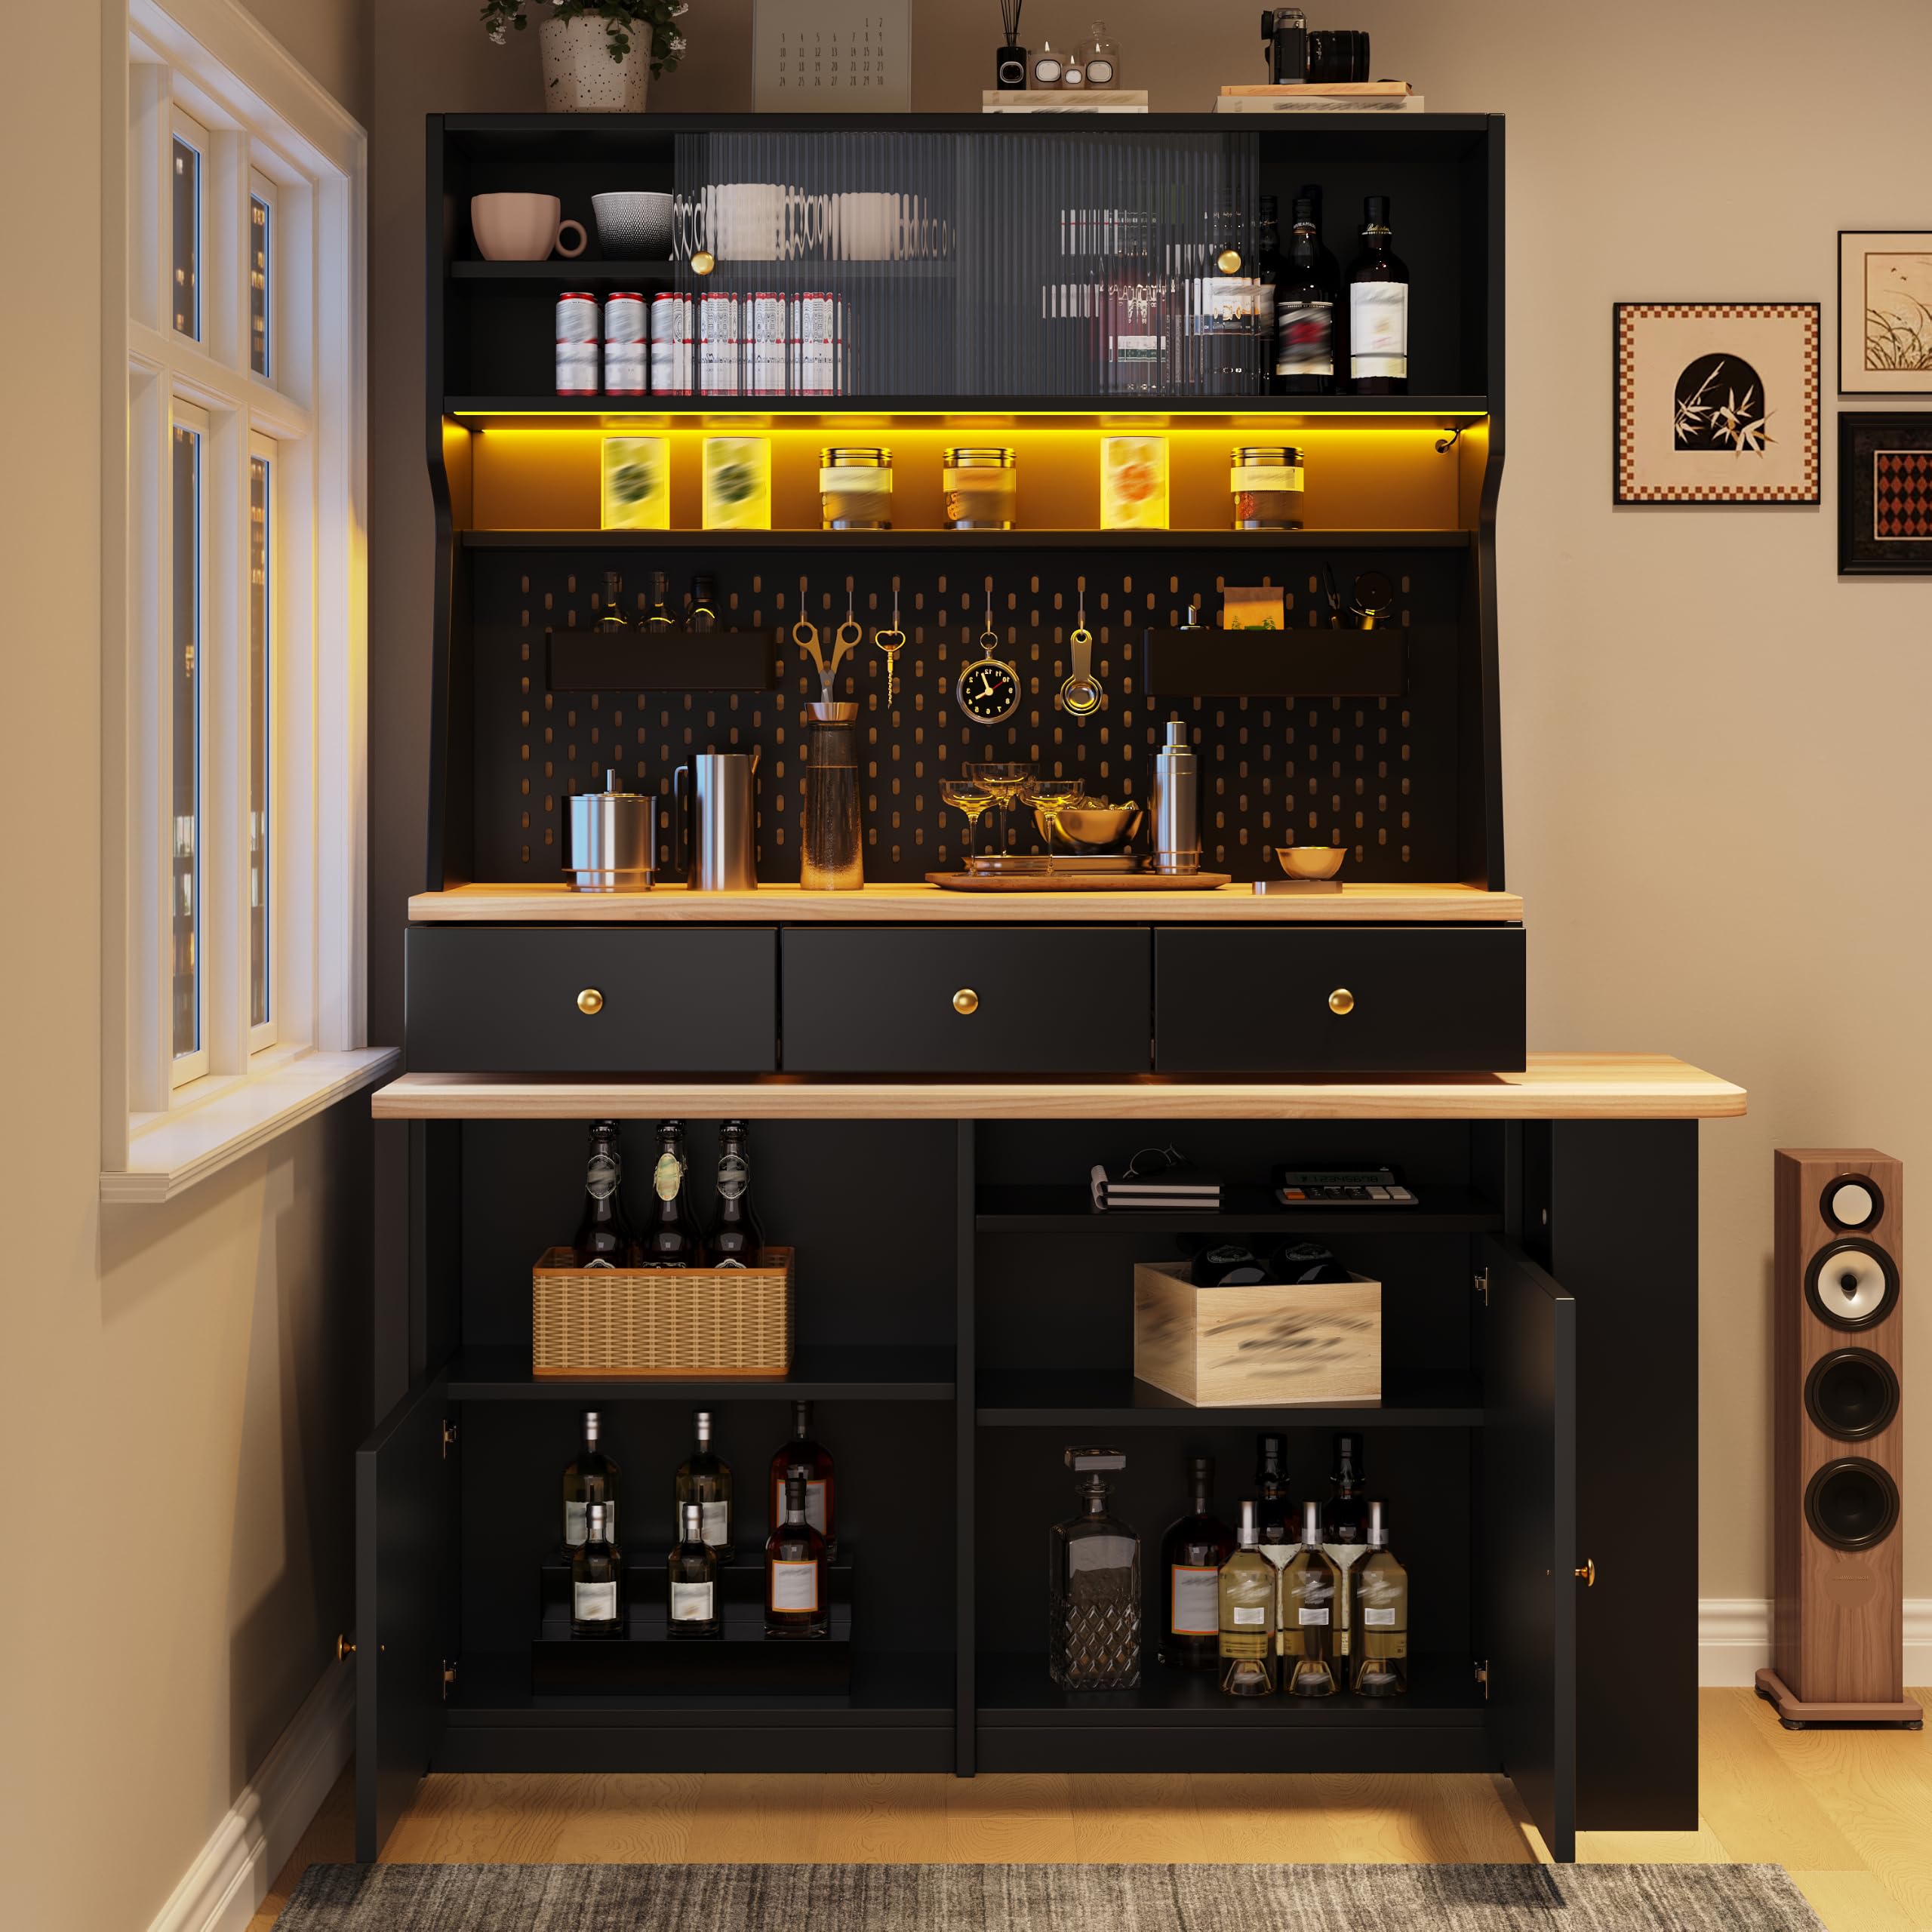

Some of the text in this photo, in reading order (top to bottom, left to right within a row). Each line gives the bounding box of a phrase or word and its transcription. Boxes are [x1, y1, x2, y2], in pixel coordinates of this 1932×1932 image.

[780, 48, 786, 57] 10
[798, 48, 804, 58] 11
[814, 47, 822, 57] 12
[831, 46, 838, 57] 13
[863, 46, 870, 57] 15
[780, 61, 786, 72] 17
[814, 61, 821, 72] 19
[831, 61, 839, 72] 20
[851, 61, 857, 72] 21
[863, 60, 870, 72] 22
[876, 60, 884, 72] 23
[779, 76, 786, 87] 24
[814, 75, 821, 87] 26
[830, 75, 838, 87] 27
[850, 75, 857, 87] 28
[863, 75, 869, 86] 29
